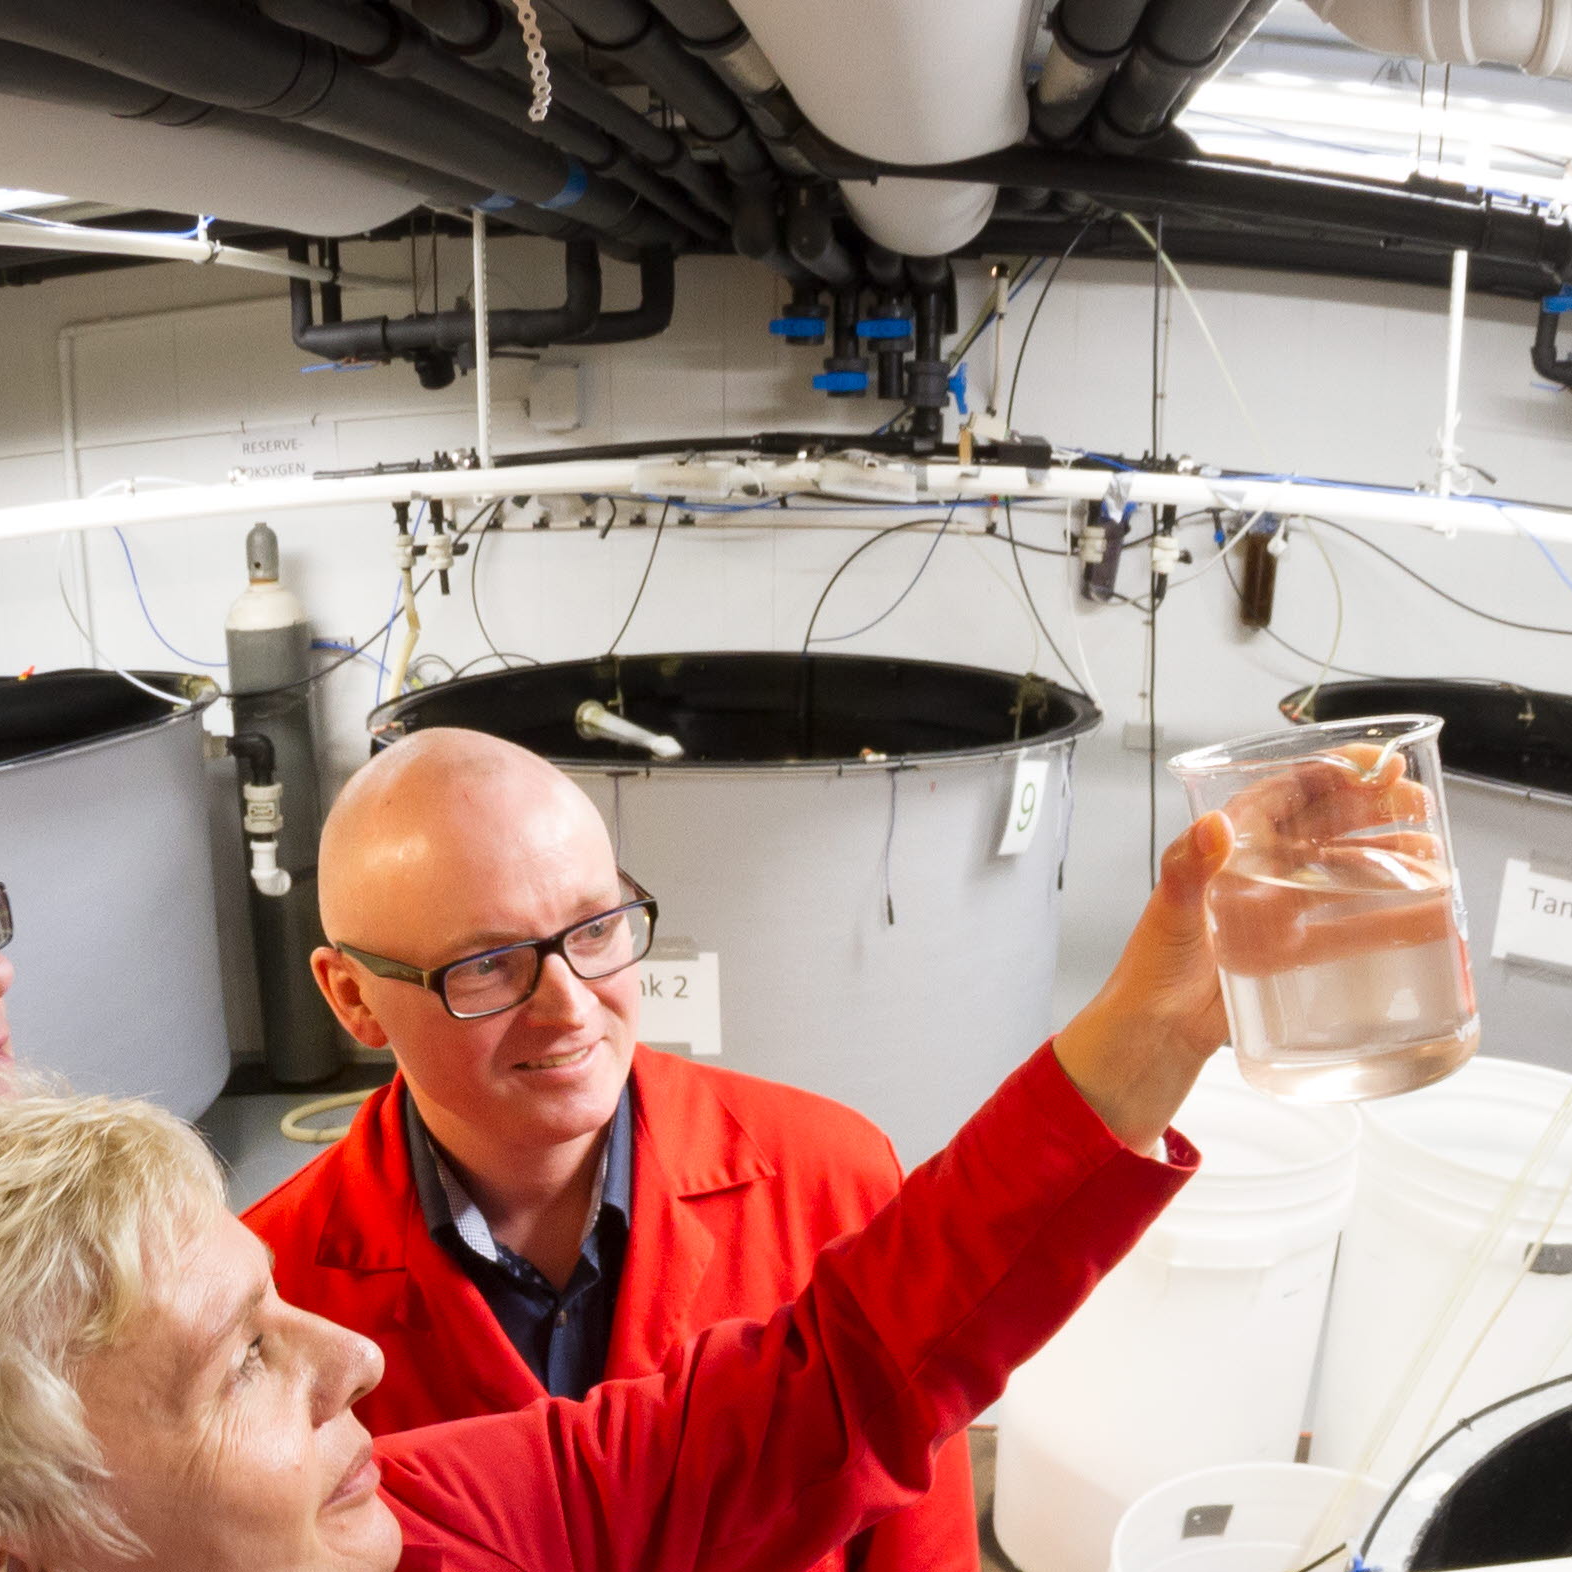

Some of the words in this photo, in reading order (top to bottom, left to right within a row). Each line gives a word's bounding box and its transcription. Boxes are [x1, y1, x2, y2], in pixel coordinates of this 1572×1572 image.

[242, 438, 304, 455] RESERVE-
[1016, 781, 1036, 832] 9
[674, 976, 689, 998] 2
